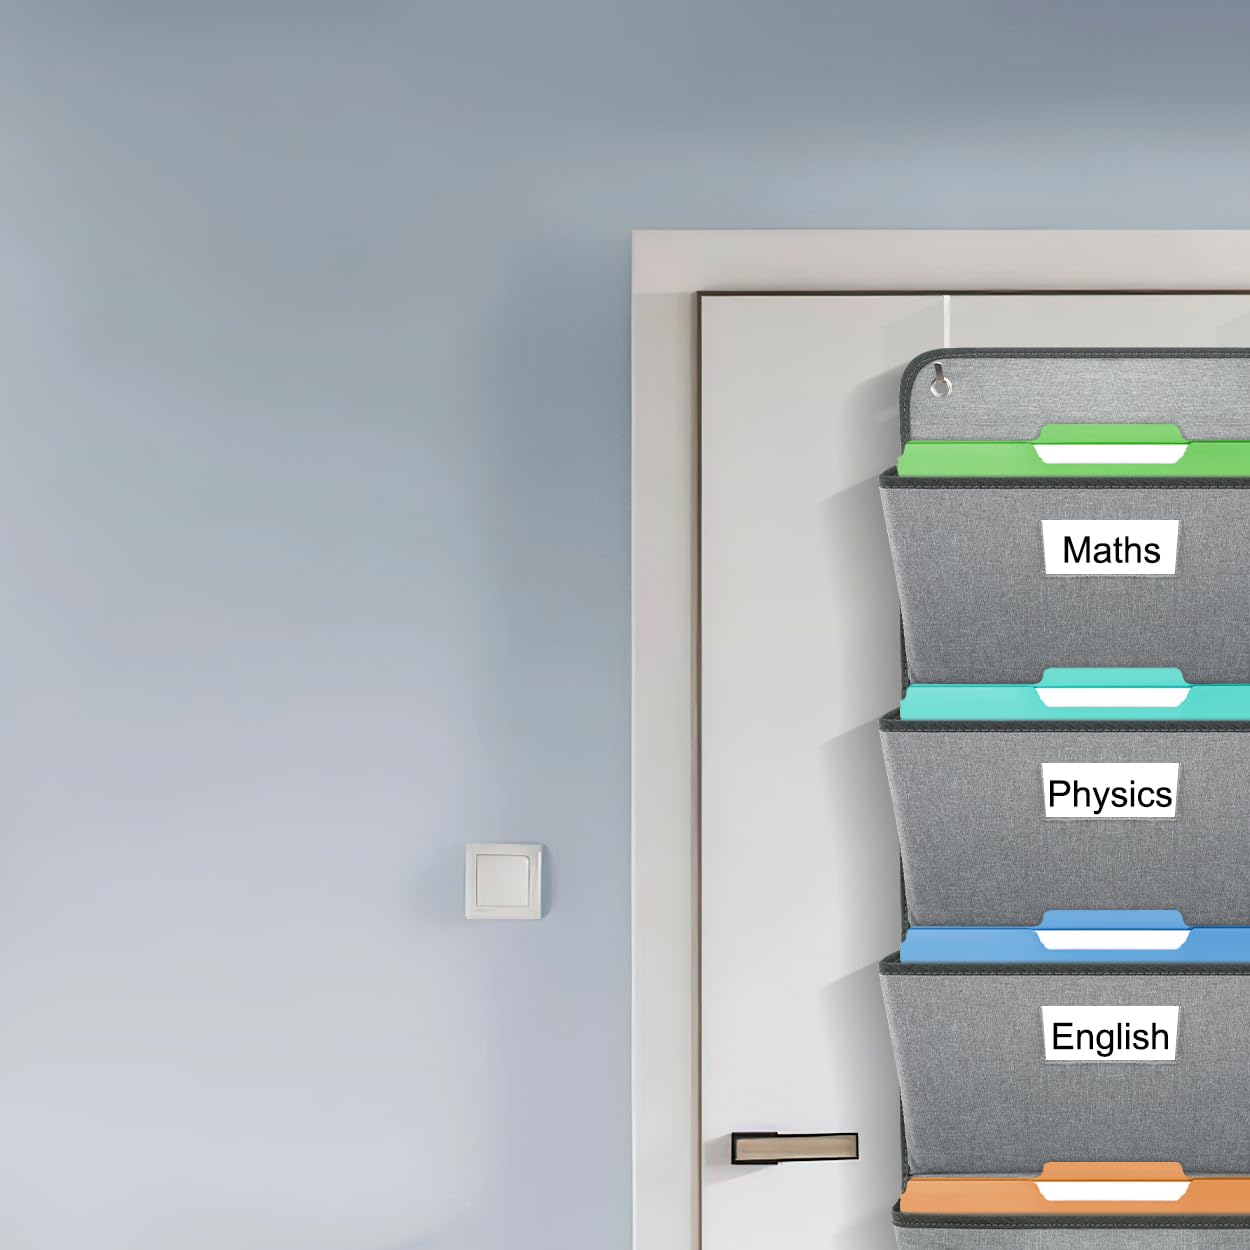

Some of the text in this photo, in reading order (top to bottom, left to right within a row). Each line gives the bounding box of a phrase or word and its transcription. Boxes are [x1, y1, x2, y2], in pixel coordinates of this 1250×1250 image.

[1064, 535, 1161, 564] Maths
[1049, 779, 1172, 815] Physics
[1053, 1022, 1169, 1058] English
